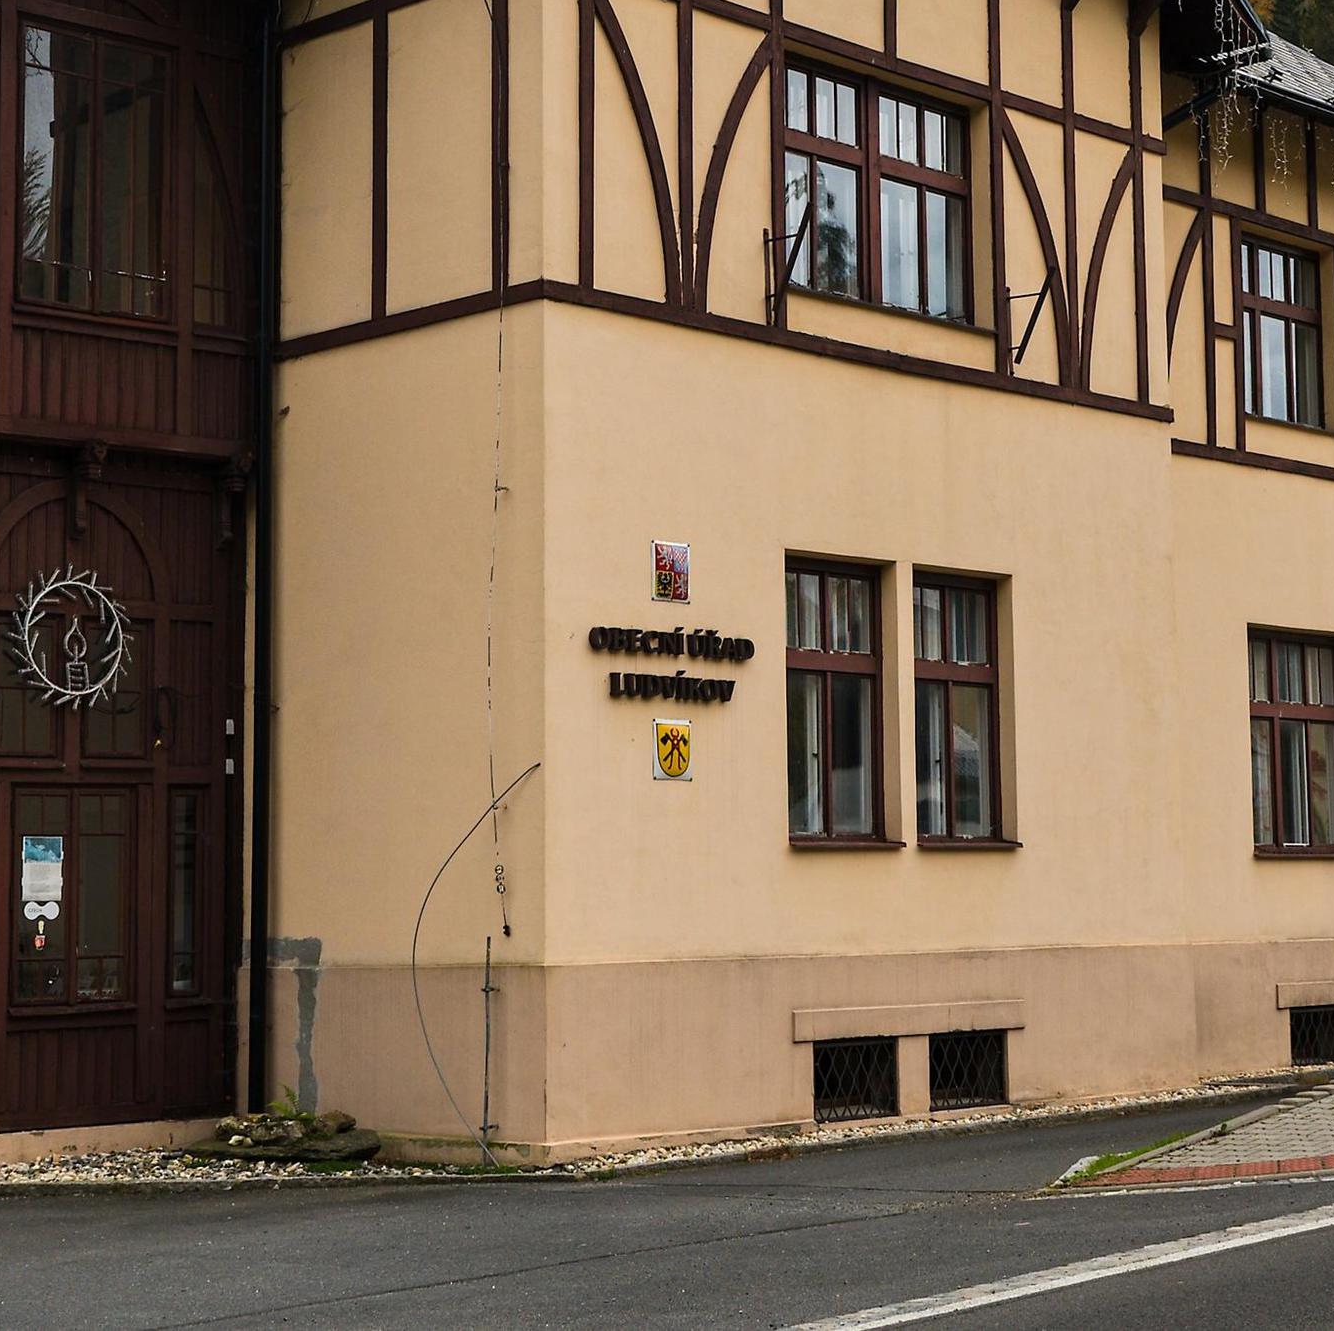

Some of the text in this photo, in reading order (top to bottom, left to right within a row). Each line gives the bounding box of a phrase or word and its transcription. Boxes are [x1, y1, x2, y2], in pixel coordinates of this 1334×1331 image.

[589, 627, 755, 661] OBECNÍ ÚŘAD
[609, 670, 736, 702] LUDVÍKOV
